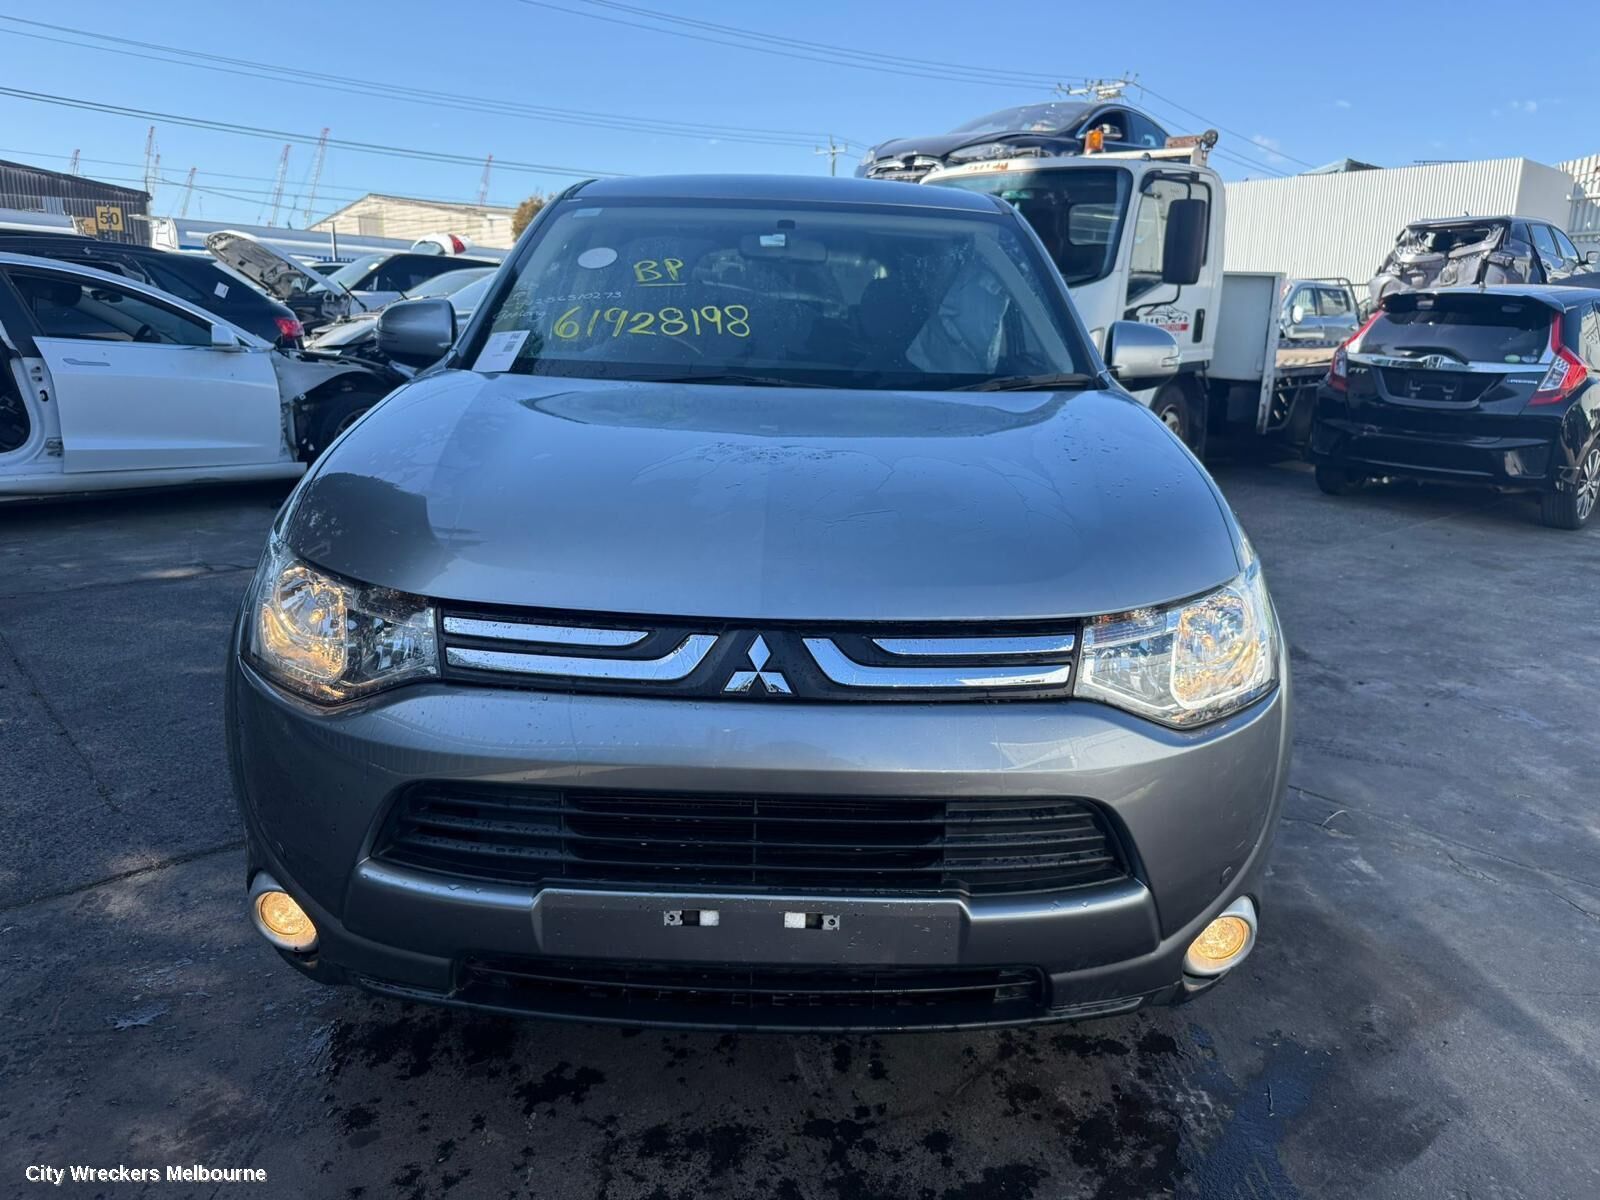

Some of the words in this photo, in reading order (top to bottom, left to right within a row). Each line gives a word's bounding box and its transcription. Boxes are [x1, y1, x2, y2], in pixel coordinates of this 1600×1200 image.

[100, 212, 120, 225] 50
[633, 258, 684, 282] BP
[554, 304, 751, 339] 61928198
